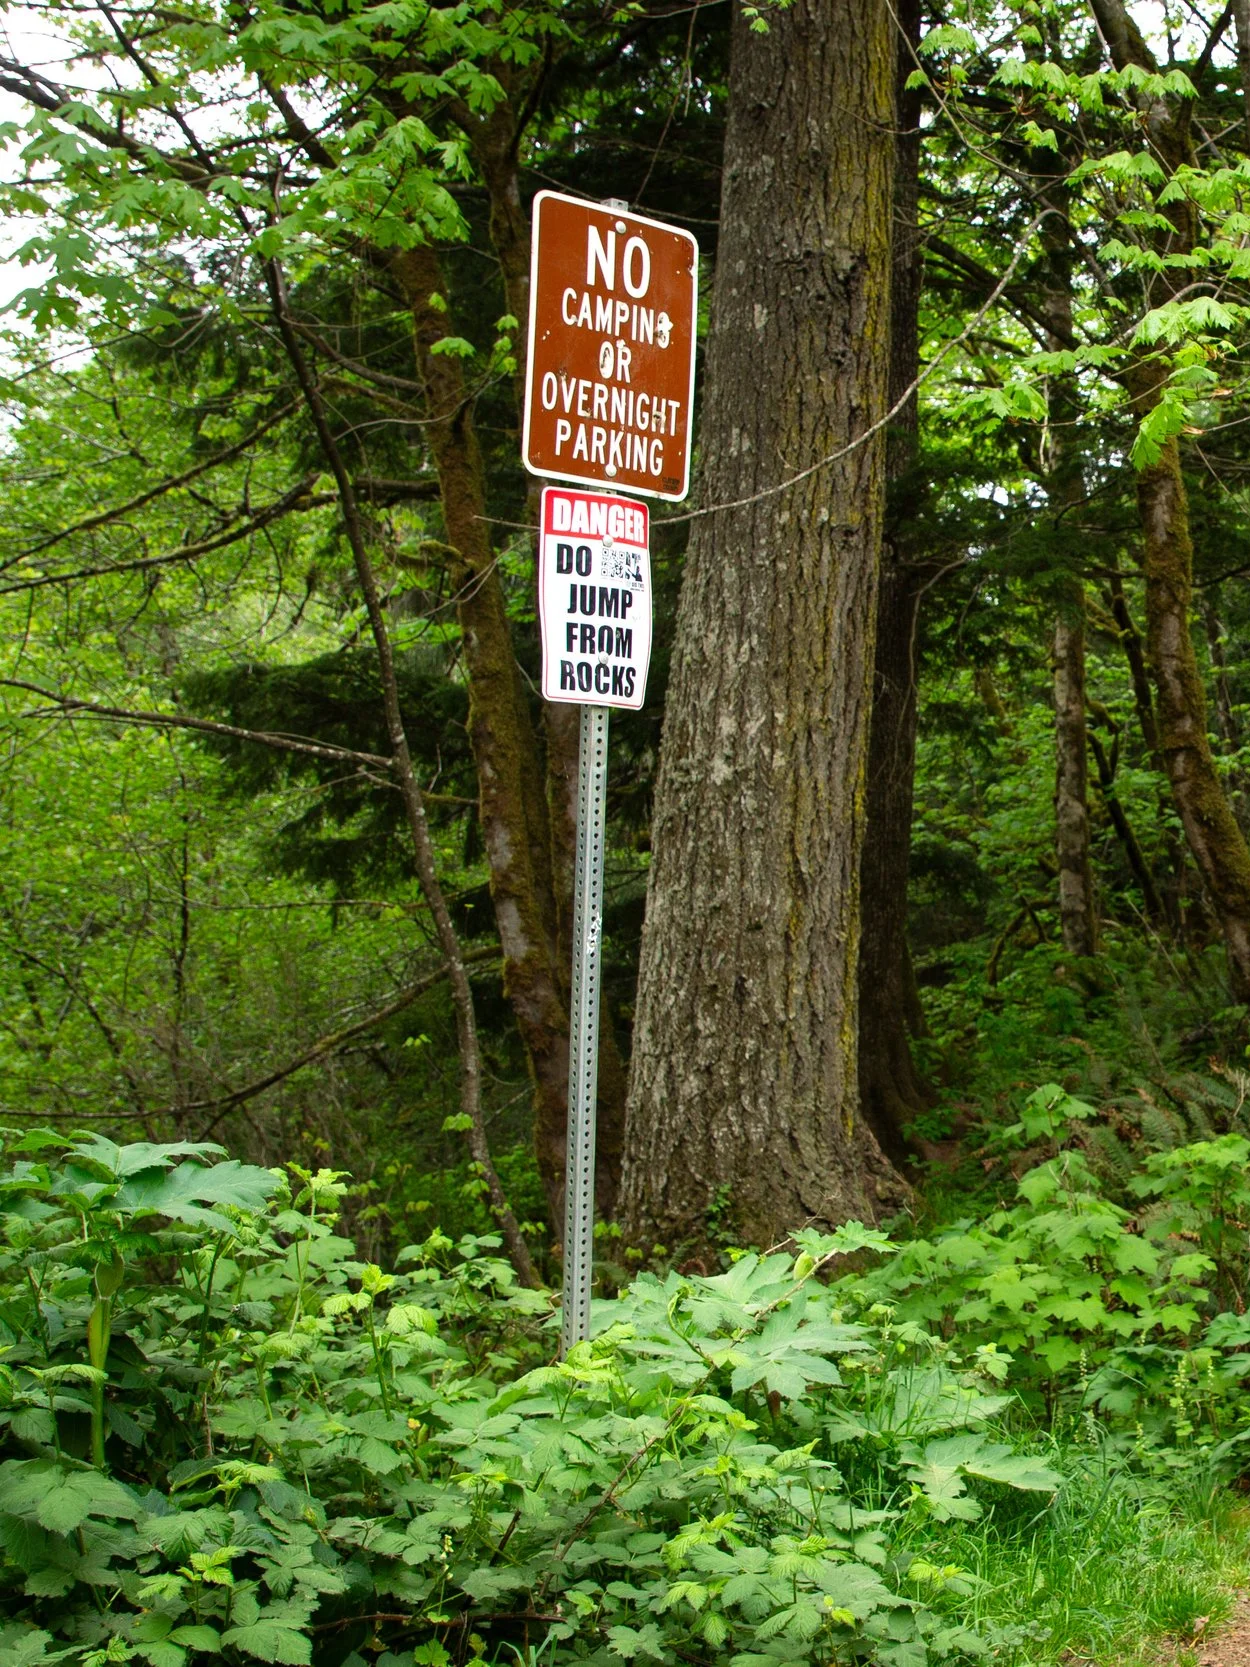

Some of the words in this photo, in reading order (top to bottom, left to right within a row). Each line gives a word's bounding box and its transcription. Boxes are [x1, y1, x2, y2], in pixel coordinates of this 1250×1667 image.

[586, 224, 651, 299] NO
[600, 340, 632, 384] OR
[541, 371, 681, 437] OVERNIGHT
[555, 418, 664, 477] PARKING
[552, 497, 645, 544] DANGER
[556, 543, 593, 577] DO
[567, 583, 633, 620] JUMP
[566, 622, 633, 659] FROM
[560, 659, 637, 698] ROCKS
